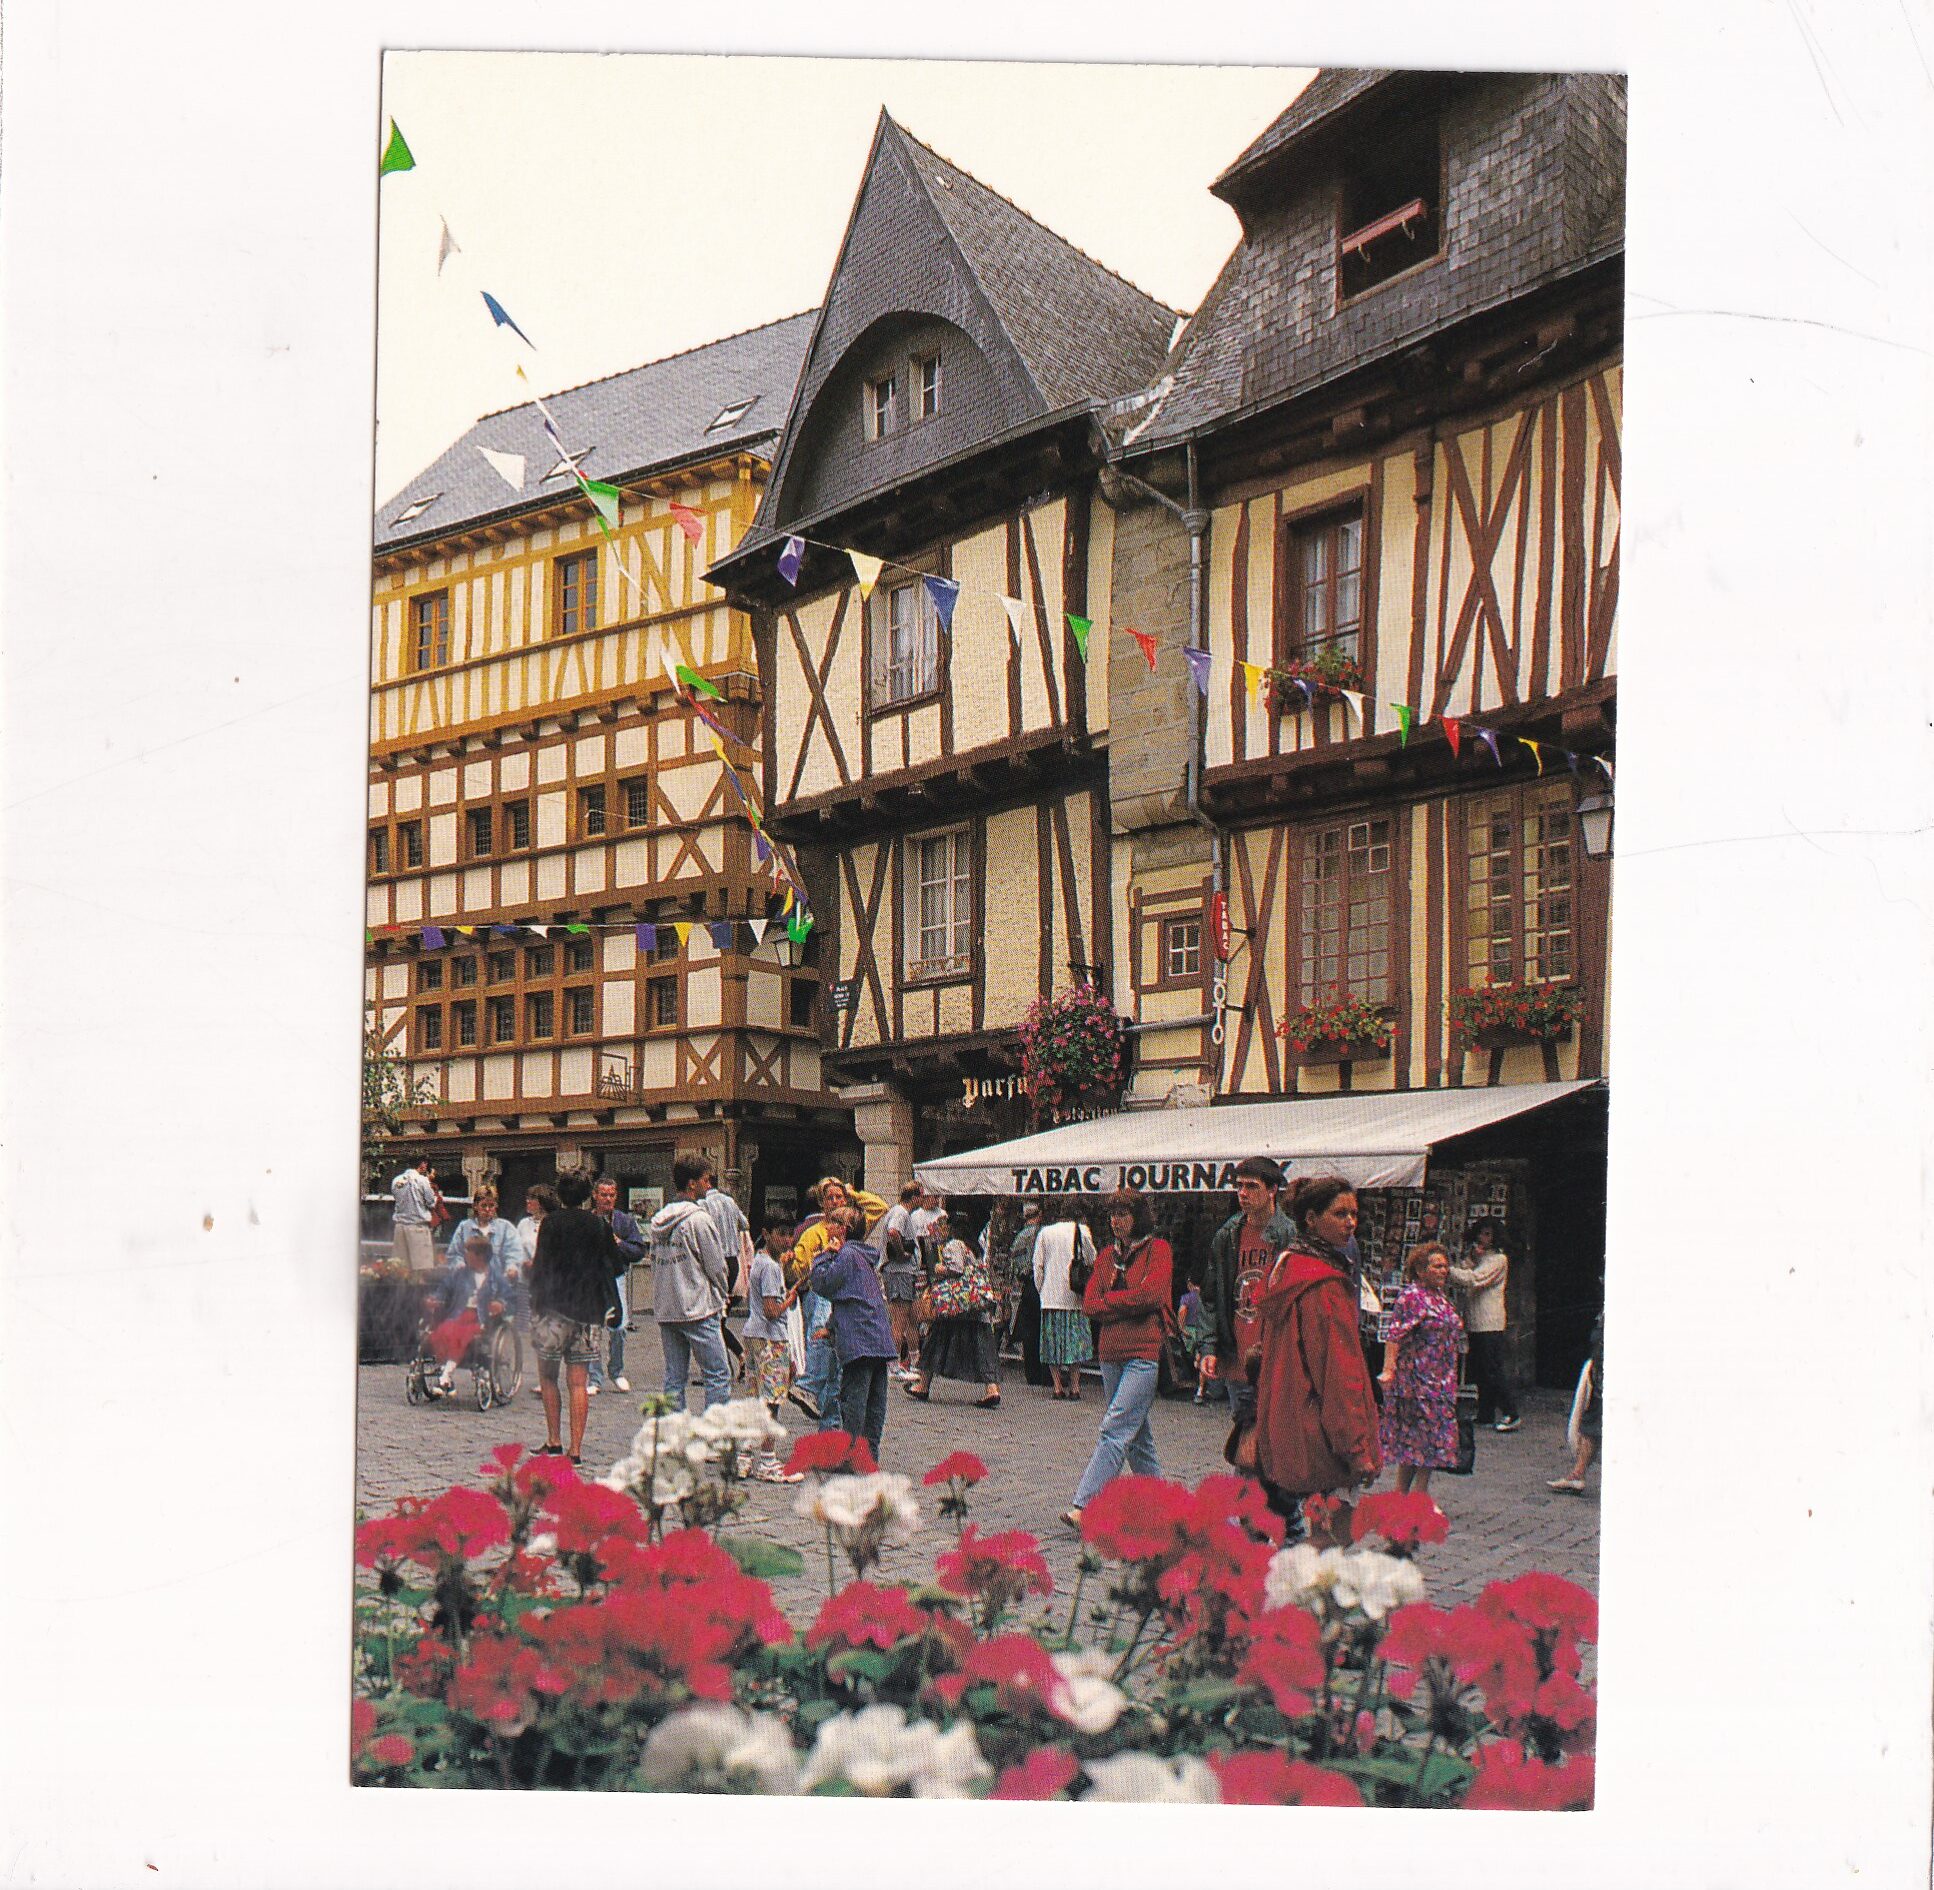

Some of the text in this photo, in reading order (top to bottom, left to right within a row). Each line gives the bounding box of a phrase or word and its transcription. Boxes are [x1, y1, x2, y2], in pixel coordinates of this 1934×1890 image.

[1220, 901, 1230, 950] TABAC
[1011, 1160, 1293, 1194] TABAC JOURNAX
